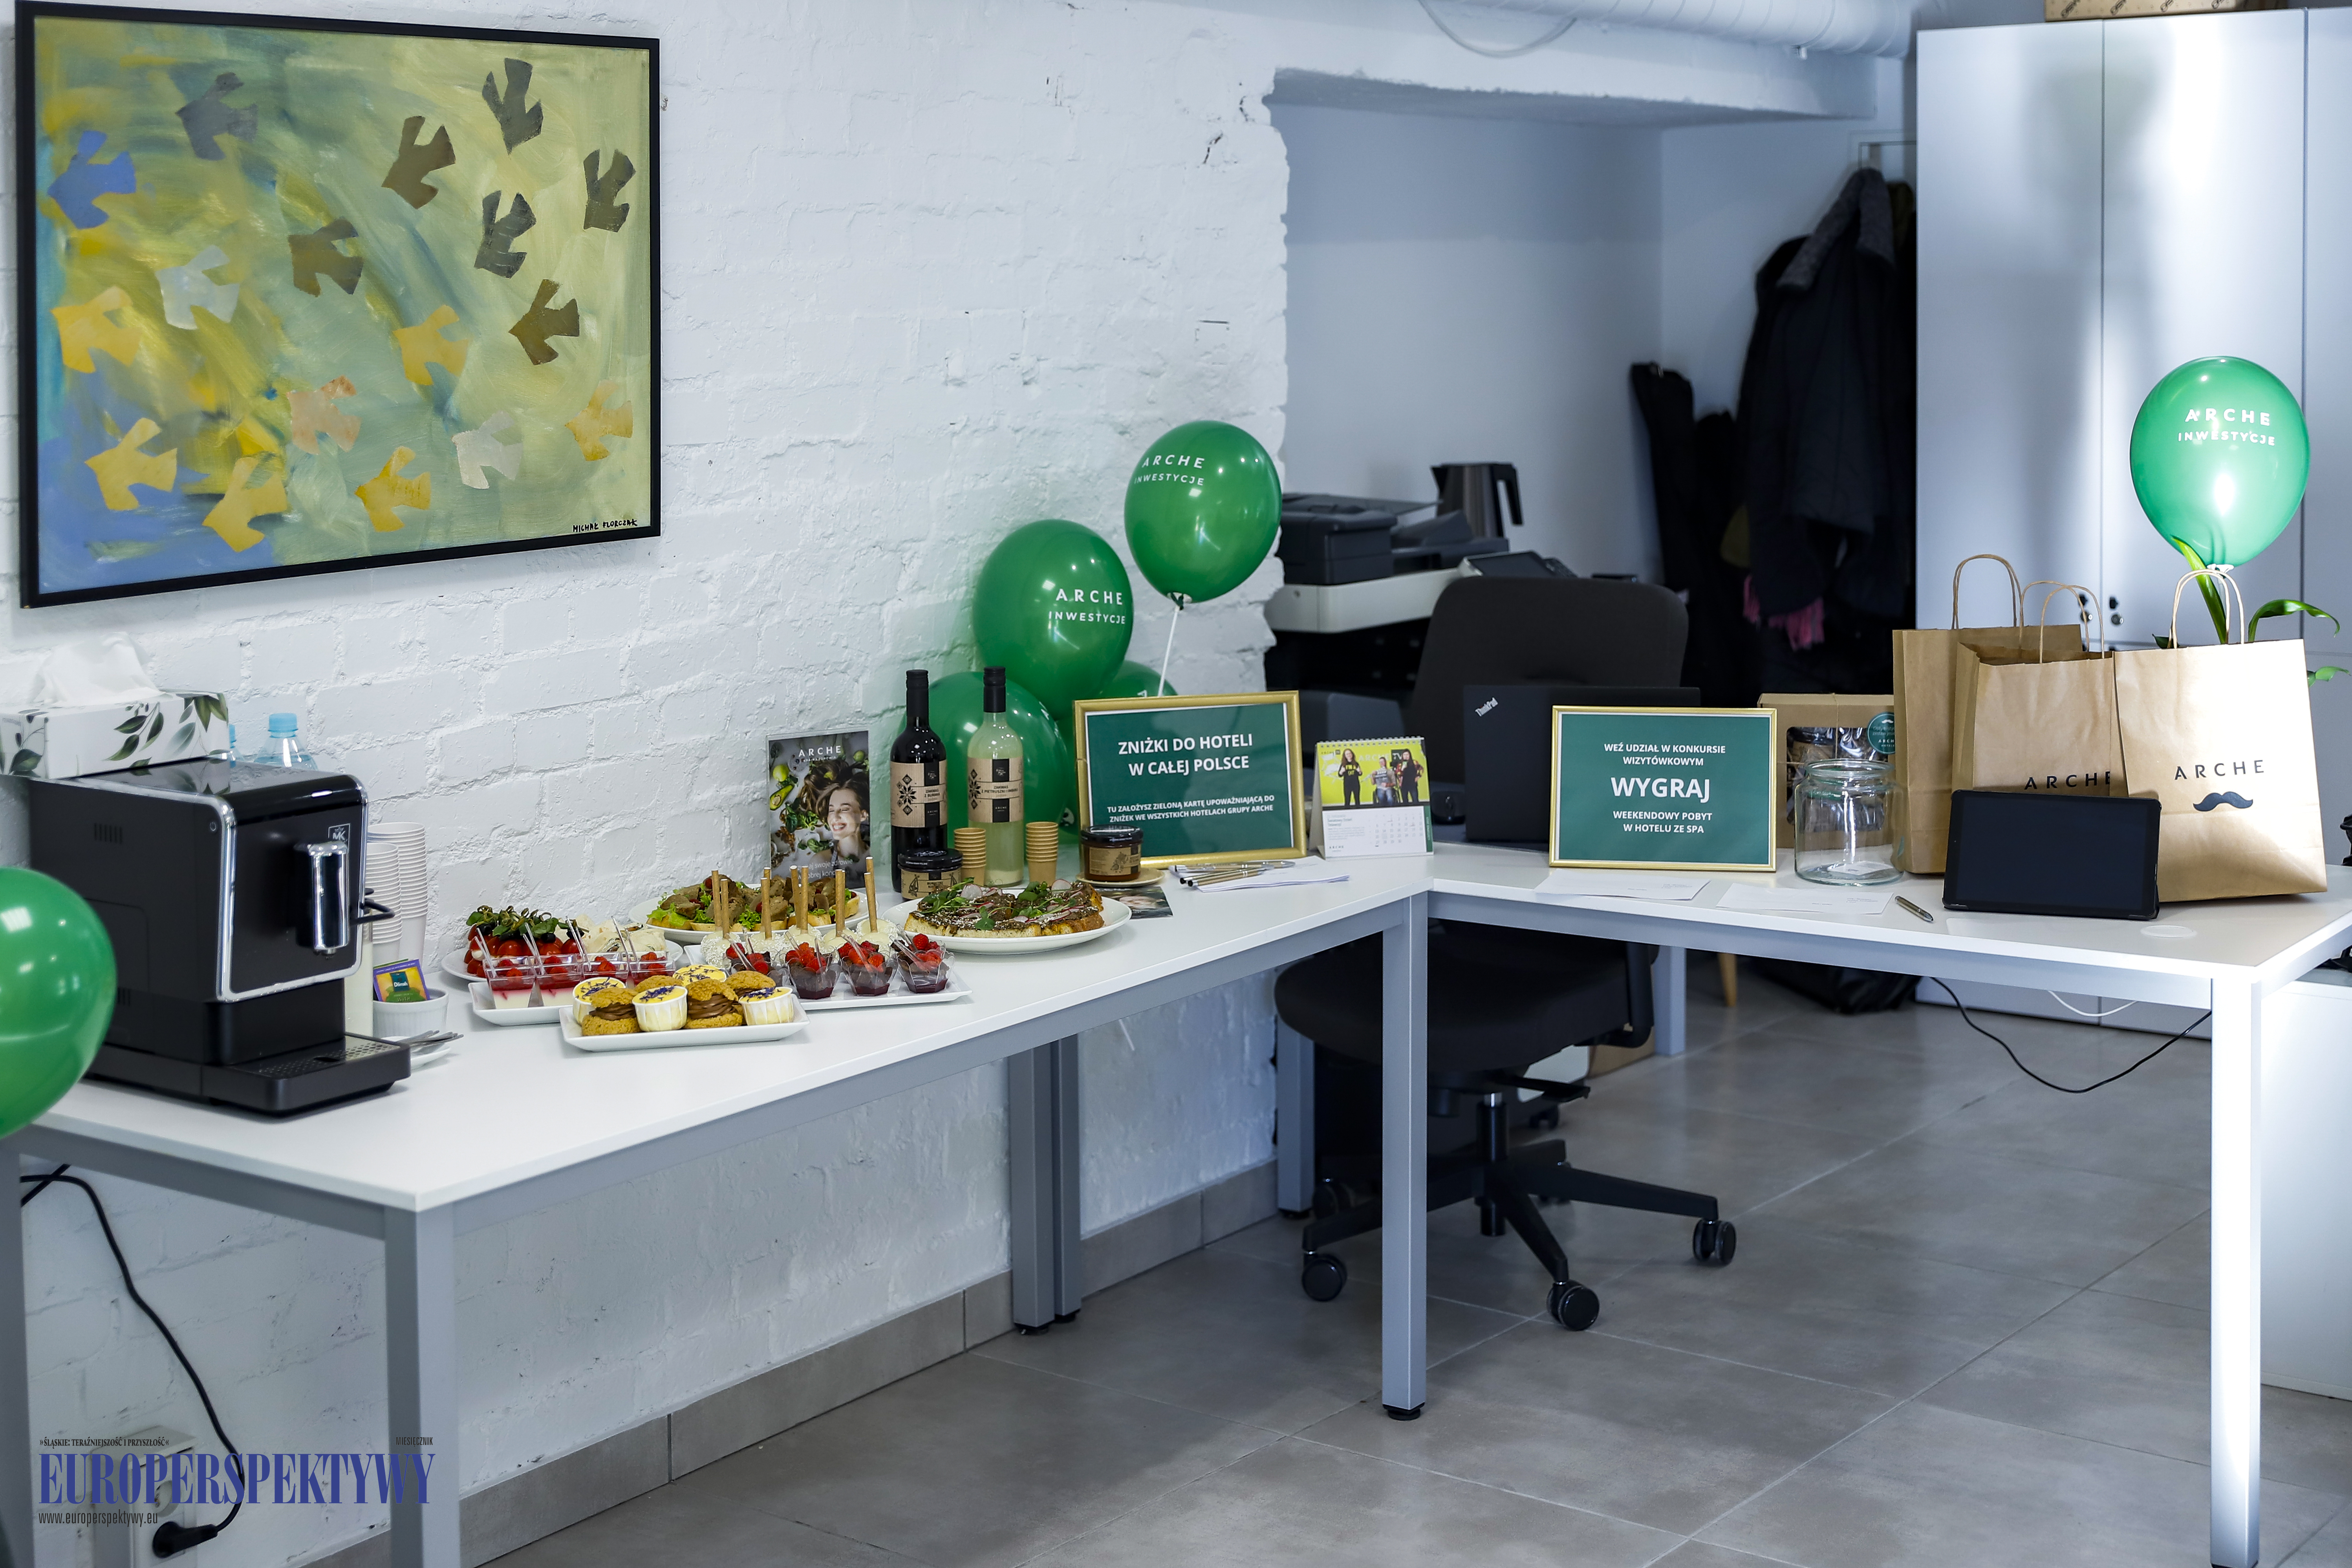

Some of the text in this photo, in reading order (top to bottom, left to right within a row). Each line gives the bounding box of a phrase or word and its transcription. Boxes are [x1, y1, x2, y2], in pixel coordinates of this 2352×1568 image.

[2185, 408, 2270, 426] ARCHE
[2178, 431, 2275, 446] INWESTYCJE
[1142, 455, 1204, 469] ARCHE
[1134, 474, 1204, 485] INWESTYCJE
[573, 519, 637, 532] MICHAŁ FLORCZAK
[1056, 589, 1122, 605] ARCHE
[1049, 611, 1126, 624] INWESTYCJE
[1118, 734, 1252, 754] ZNIŻKI DO HOTELI
[1604, 742, 1624, 752] WEŹ
[1626, 744, 1659, 752] UDZIAŁ
[1673, 745, 1726, 754] KONKURSIE
[799, 746, 841, 757] ARCHE
[1128, 756, 1249, 776] W CAŁEJ POLSCE
[1623, 755, 1704, 766] WIZYTÓWKOWYM
[2174, 760, 2264, 780] ARCHE
[1611, 777, 1710, 803] WYGRAJ
[1153, 801, 1182, 811] ZIELONĄ
[1184, 800, 1204, 808] KARTĘ
[1206, 796, 1263, 806] UPOWAŻNIAJĄCĄ
[1109, 814, 1134, 822] ZNIŻEK
[1147, 811, 1188, 820] WSZYSTKICH
[1190, 809, 1225, 817] HOTELACH
[1613, 811, 1713, 821] WEEKENDOWY POBYT
[1623, 823, 1704, 833] W HOTELU ZE SPA
[333, 831, 345, 840] MK
